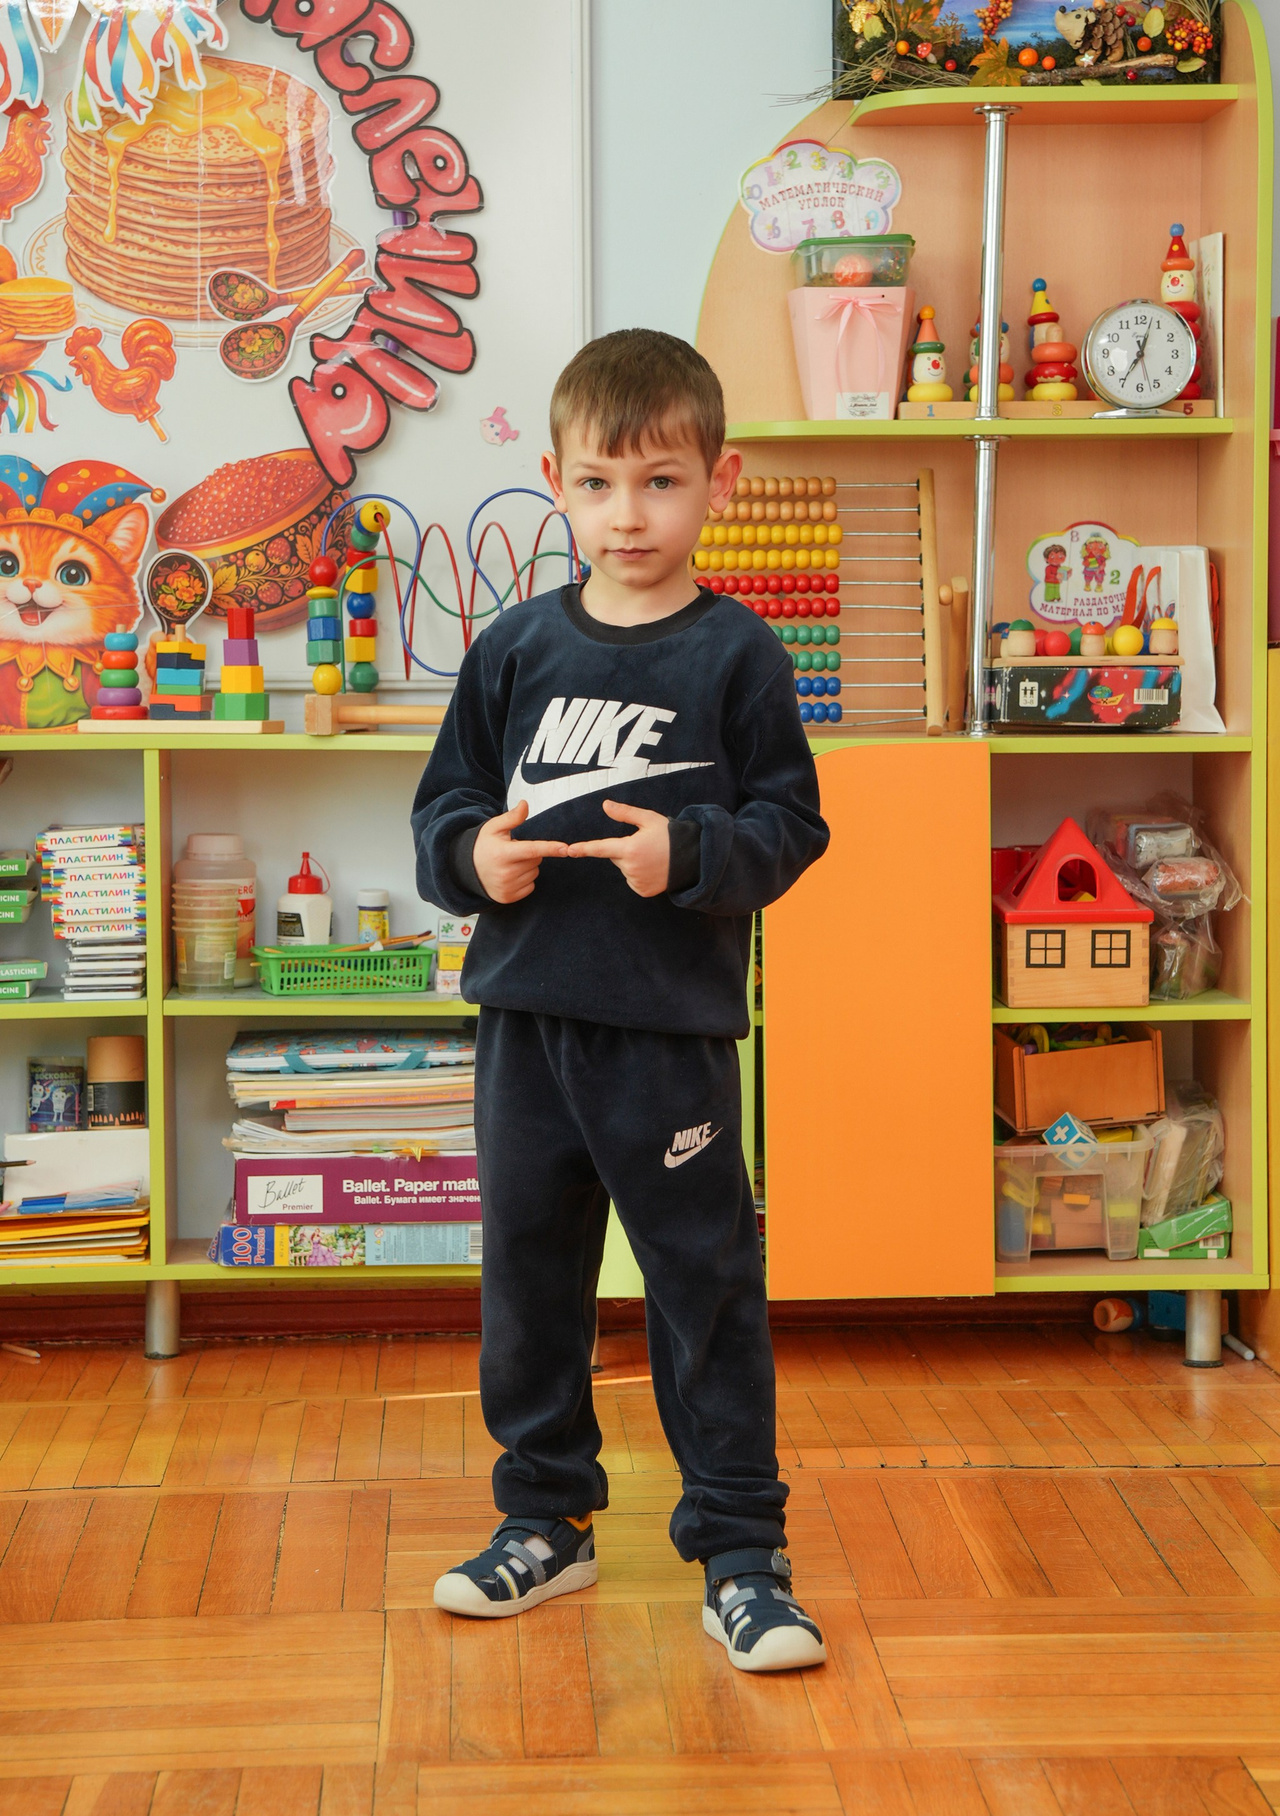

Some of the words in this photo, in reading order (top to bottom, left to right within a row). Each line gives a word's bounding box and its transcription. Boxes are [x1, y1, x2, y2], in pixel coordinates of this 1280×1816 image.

[759, 182, 885, 211] МАТЕМАТИЧЕСКИЙ
[798, 197, 845, 210] УГОЛОК
[832, 210, 845, 229] 8
[1119, 320, 1130, 329] 11
[1134, 315, 1147, 325] 12
[1156, 320, 1161, 329] 1
[1107, 333, 1120, 343] 10
[1167, 333, 1174, 342] 2
[1102, 349, 1109, 359] 9
[1171, 349, 1179, 359] 3
[1107, 366, 1115, 376] 8
[1165, 366, 1172, 375] 4
[1119, 378, 1126, 388] 7
[1136, 383, 1144, 393] 6
[1153, 379, 1161, 389] 5
[927, 404, 935, 417] 1
[1052, 404, 1062, 416] 3
[1183, 403, 1194, 415] 5
[1071, 530, 1079, 542] 8
[1110, 569, 1120, 585] 2
[1039, 603, 1093, 617] МАТЕРИАЛ
[1097, 608, 1109, 616] ПО
[525, 697, 678, 768] NIKE
[50, 833, 115, 845] ПЛАСТИЛИН
[58, 853, 123, 865] ПЛАСТИЛИН
[69, 872, 135, 882] ПЛАСТИЛИН
[65, 889, 130, 899] ПЛАСТИЛИН
[66, 906, 131, 917] ПЛАСТИЛИН
[67, 924, 132, 934] ПЛАСТИЛИН
[671, 1121, 712, 1152] NIKE
[342, 1179, 390, 1193] Ballet.
[394, 1178, 439, 1195] Paper
[258, 1177, 307, 1209] Ballet
[354, 1196, 381, 1205] Ballet.
[384, 1196, 417, 1206] Бумага
[419, 1195, 447, 1204] имеет
[282, 1203, 314, 1211] Premier
[232, 1227, 252, 1265] 100
[253, 1228, 266, 1265] Puzzle
